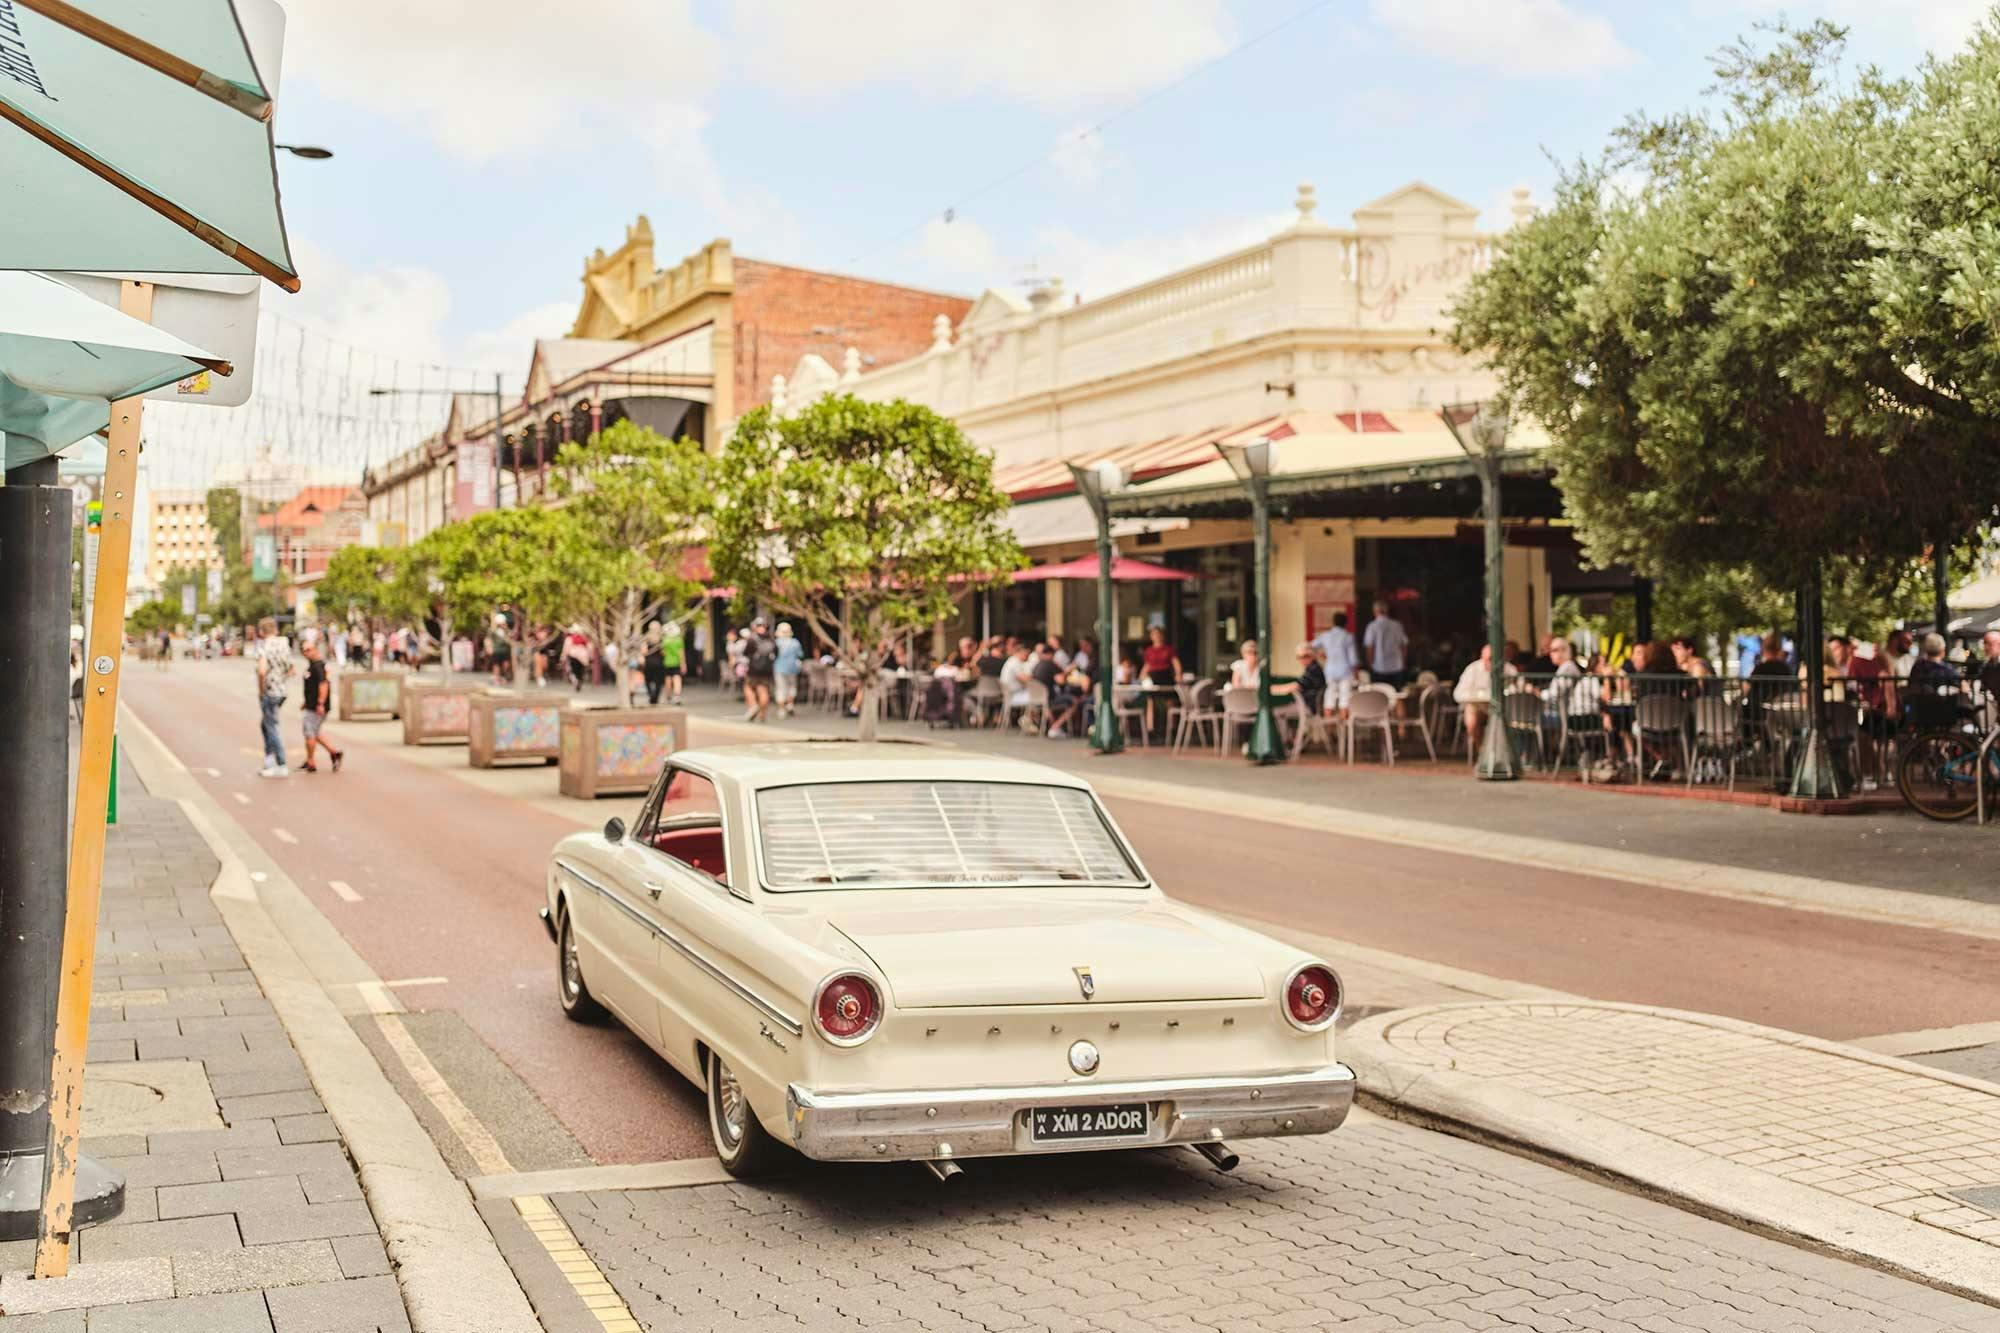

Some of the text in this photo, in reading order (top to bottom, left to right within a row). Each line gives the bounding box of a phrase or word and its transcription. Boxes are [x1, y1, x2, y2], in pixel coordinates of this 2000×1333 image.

[1052, 1110, 1143, 1133] XM 2 ADOR
